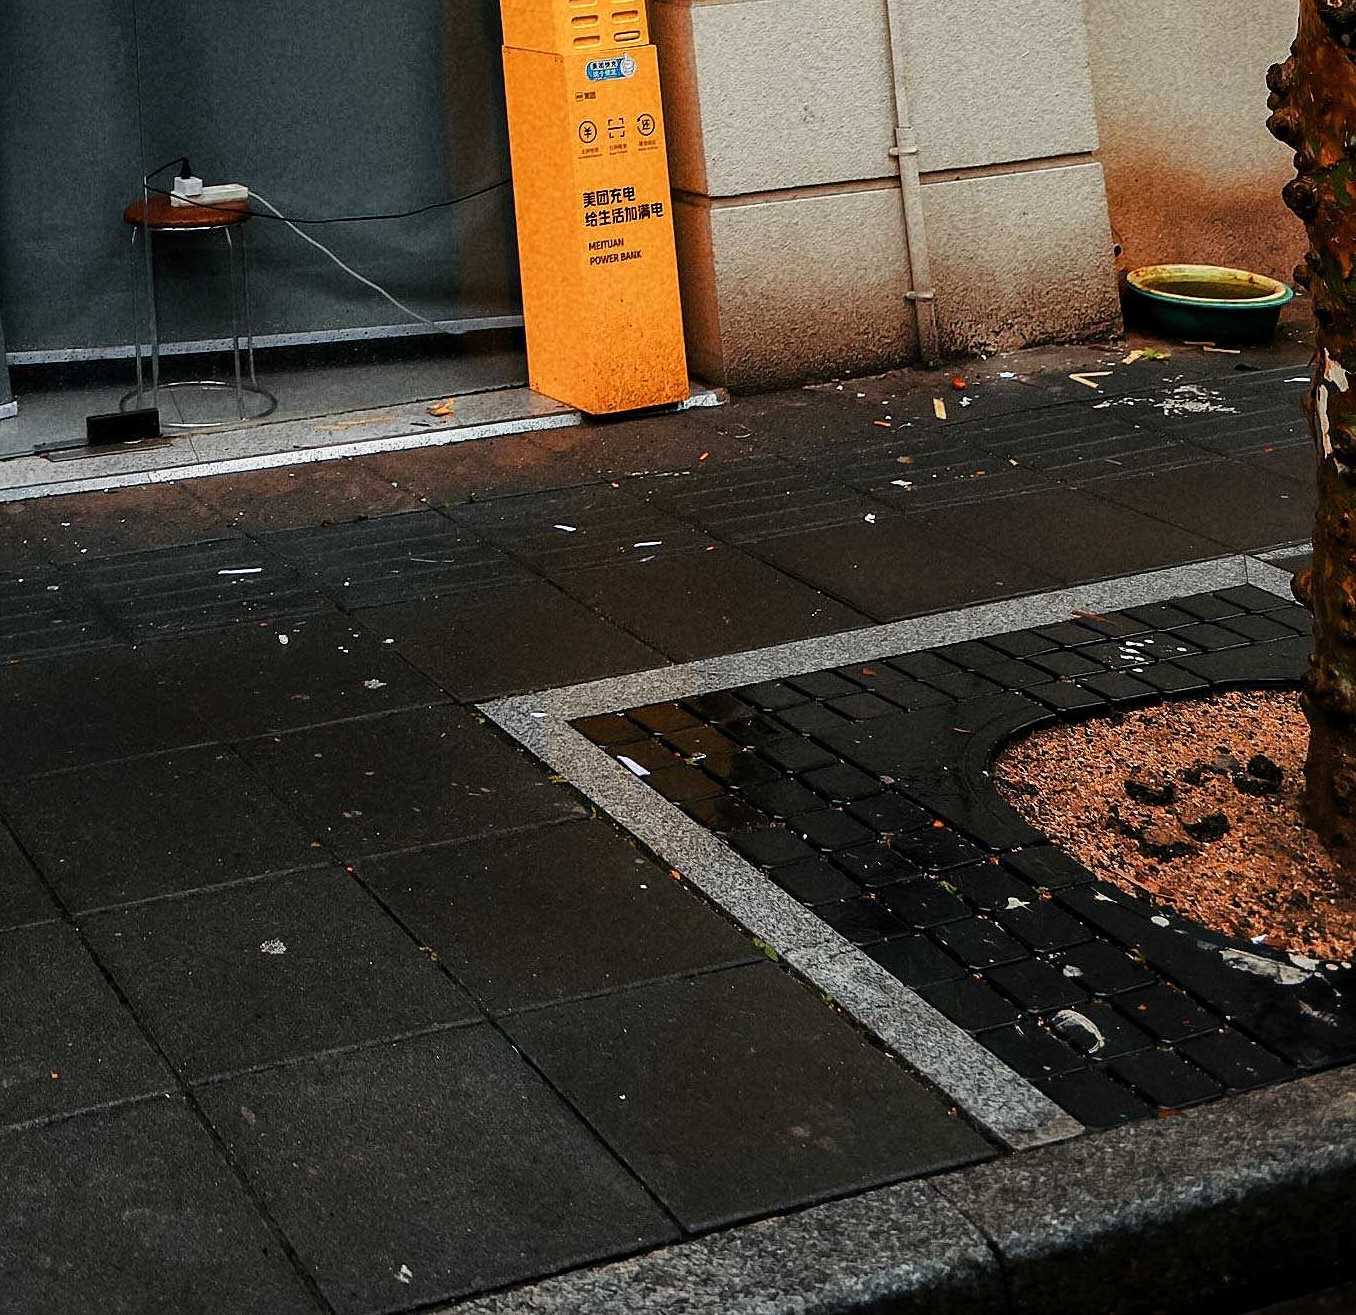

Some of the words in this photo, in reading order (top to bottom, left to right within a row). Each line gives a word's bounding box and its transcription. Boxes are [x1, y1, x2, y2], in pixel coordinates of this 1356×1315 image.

[582, 186, 636, 209] 美团充电
[584, 202, 664, 227] 给生活加满电
[588, 237, 624, 251] MEITUAN
[590, 253, 619, 266] POWER
[621, 249, 642, 262] BANK
